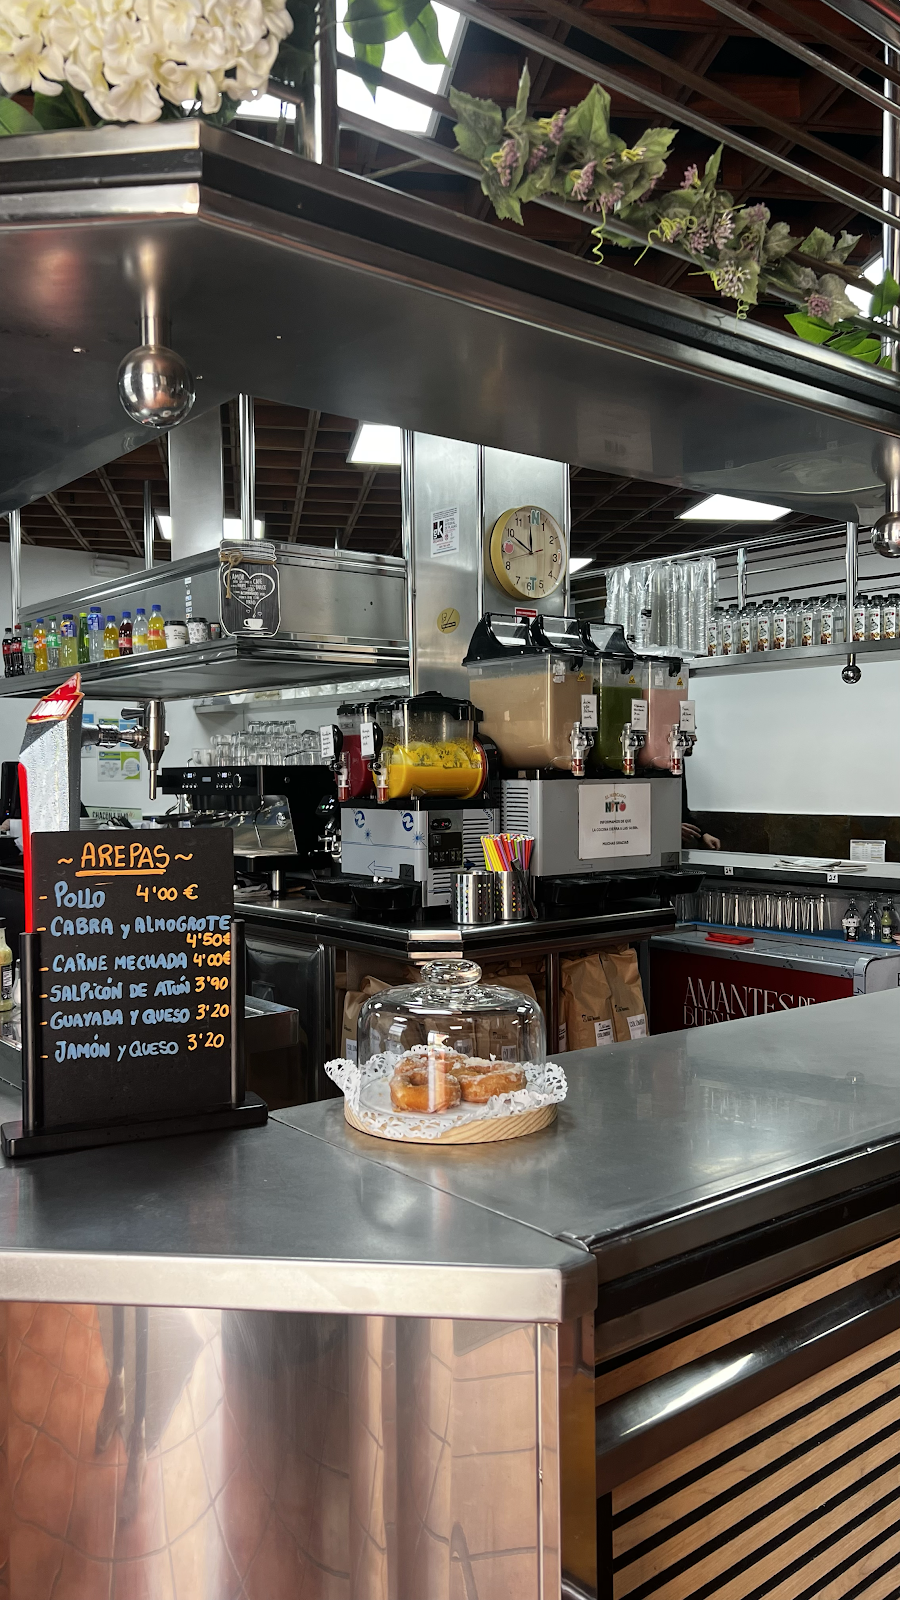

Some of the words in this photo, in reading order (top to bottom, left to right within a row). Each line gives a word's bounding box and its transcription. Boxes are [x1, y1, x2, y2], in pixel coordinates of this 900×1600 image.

[507, 528, 514, 538] 10
[549, 536, 554, 544] 2
[506, 561, 510, 570] 8
[552, 554, 558, 562] 3
[516, 576, 520, 585] 7
[526, 582, 532, 591] 6
[538, 580, 544, 588] 5
[81, 842, 170, 868] AREPAS
[54, 881, 106, 909] POLLO
[136, 884, 178, 902] 4'00
[182, 884, 198, 900] €
[50, 916, 114, 937] CABRA
[134, 914, 232, 934] ALMOGROTE
[52, 952, 108, 973] CARNE
[114, 952, 188, 971] MECHADA
[129, 982, 148, 998] DE
[154, 975, 191, 996] ATÚN
[194, 976, 229, 992] 3'90
[684, 976, 794, 1016] AMANTES
[50, 1008, 124, 1030] GUAYABA
[142, 1008, 190, 1024] QUESO
[196, 1004, 230, 1020] 3'20
[54, 1034, 110, 1063] JAMÓN
[128, 1040, 180, 1058] QUESO
[187, 1032, 225, 1051] 3'20
